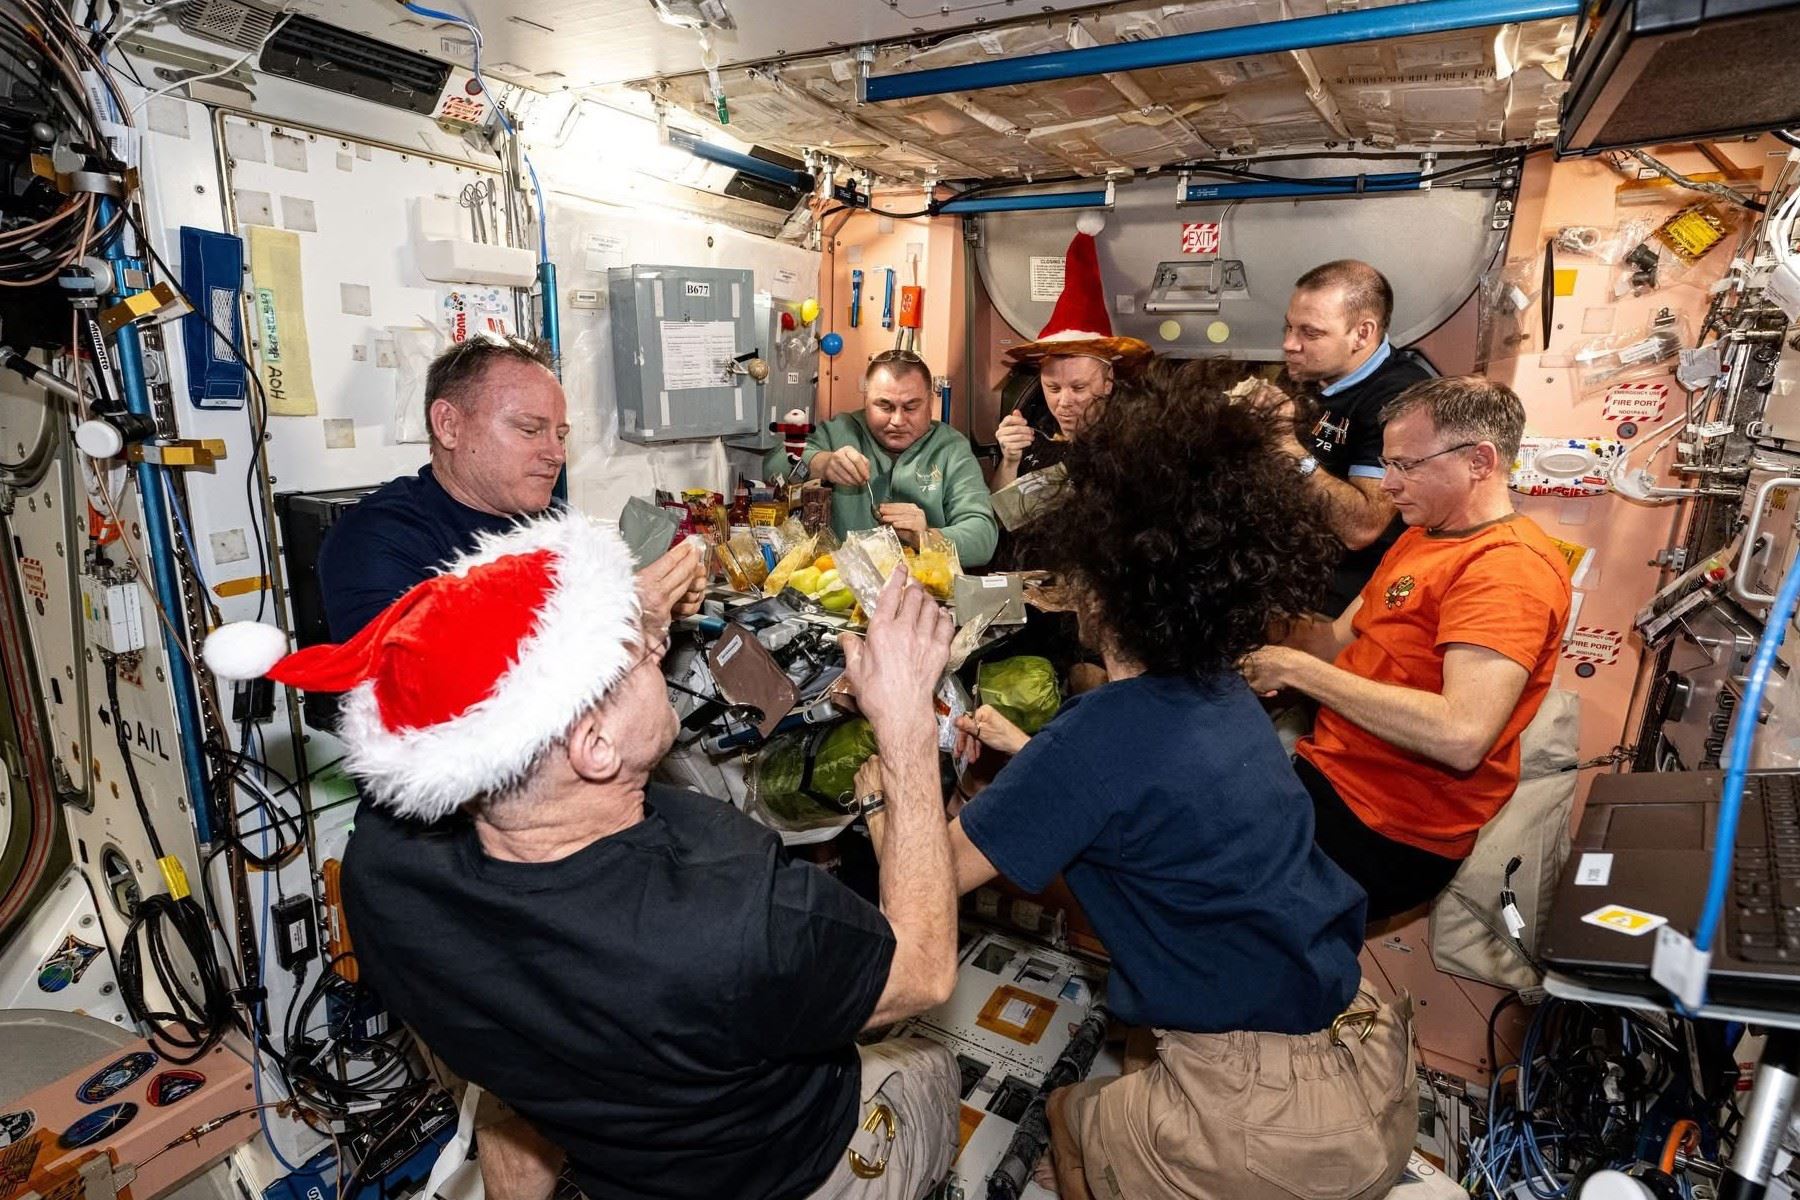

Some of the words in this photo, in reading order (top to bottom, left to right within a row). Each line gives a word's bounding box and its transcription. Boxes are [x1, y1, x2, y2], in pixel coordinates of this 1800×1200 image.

[1187, 231, 1212, 247] EXIT
[687, 284, 709, 295] B677
[90, 323, 109, 370] Manfrotto
[1633, 399, 1658, 407] PORT
[1315, 438, 1333, 452] 72
[919, 483, 937, 492] 72
[1570, 639, 1589, 648] FIRE
[1590, 643, 1613, 651] PORT
